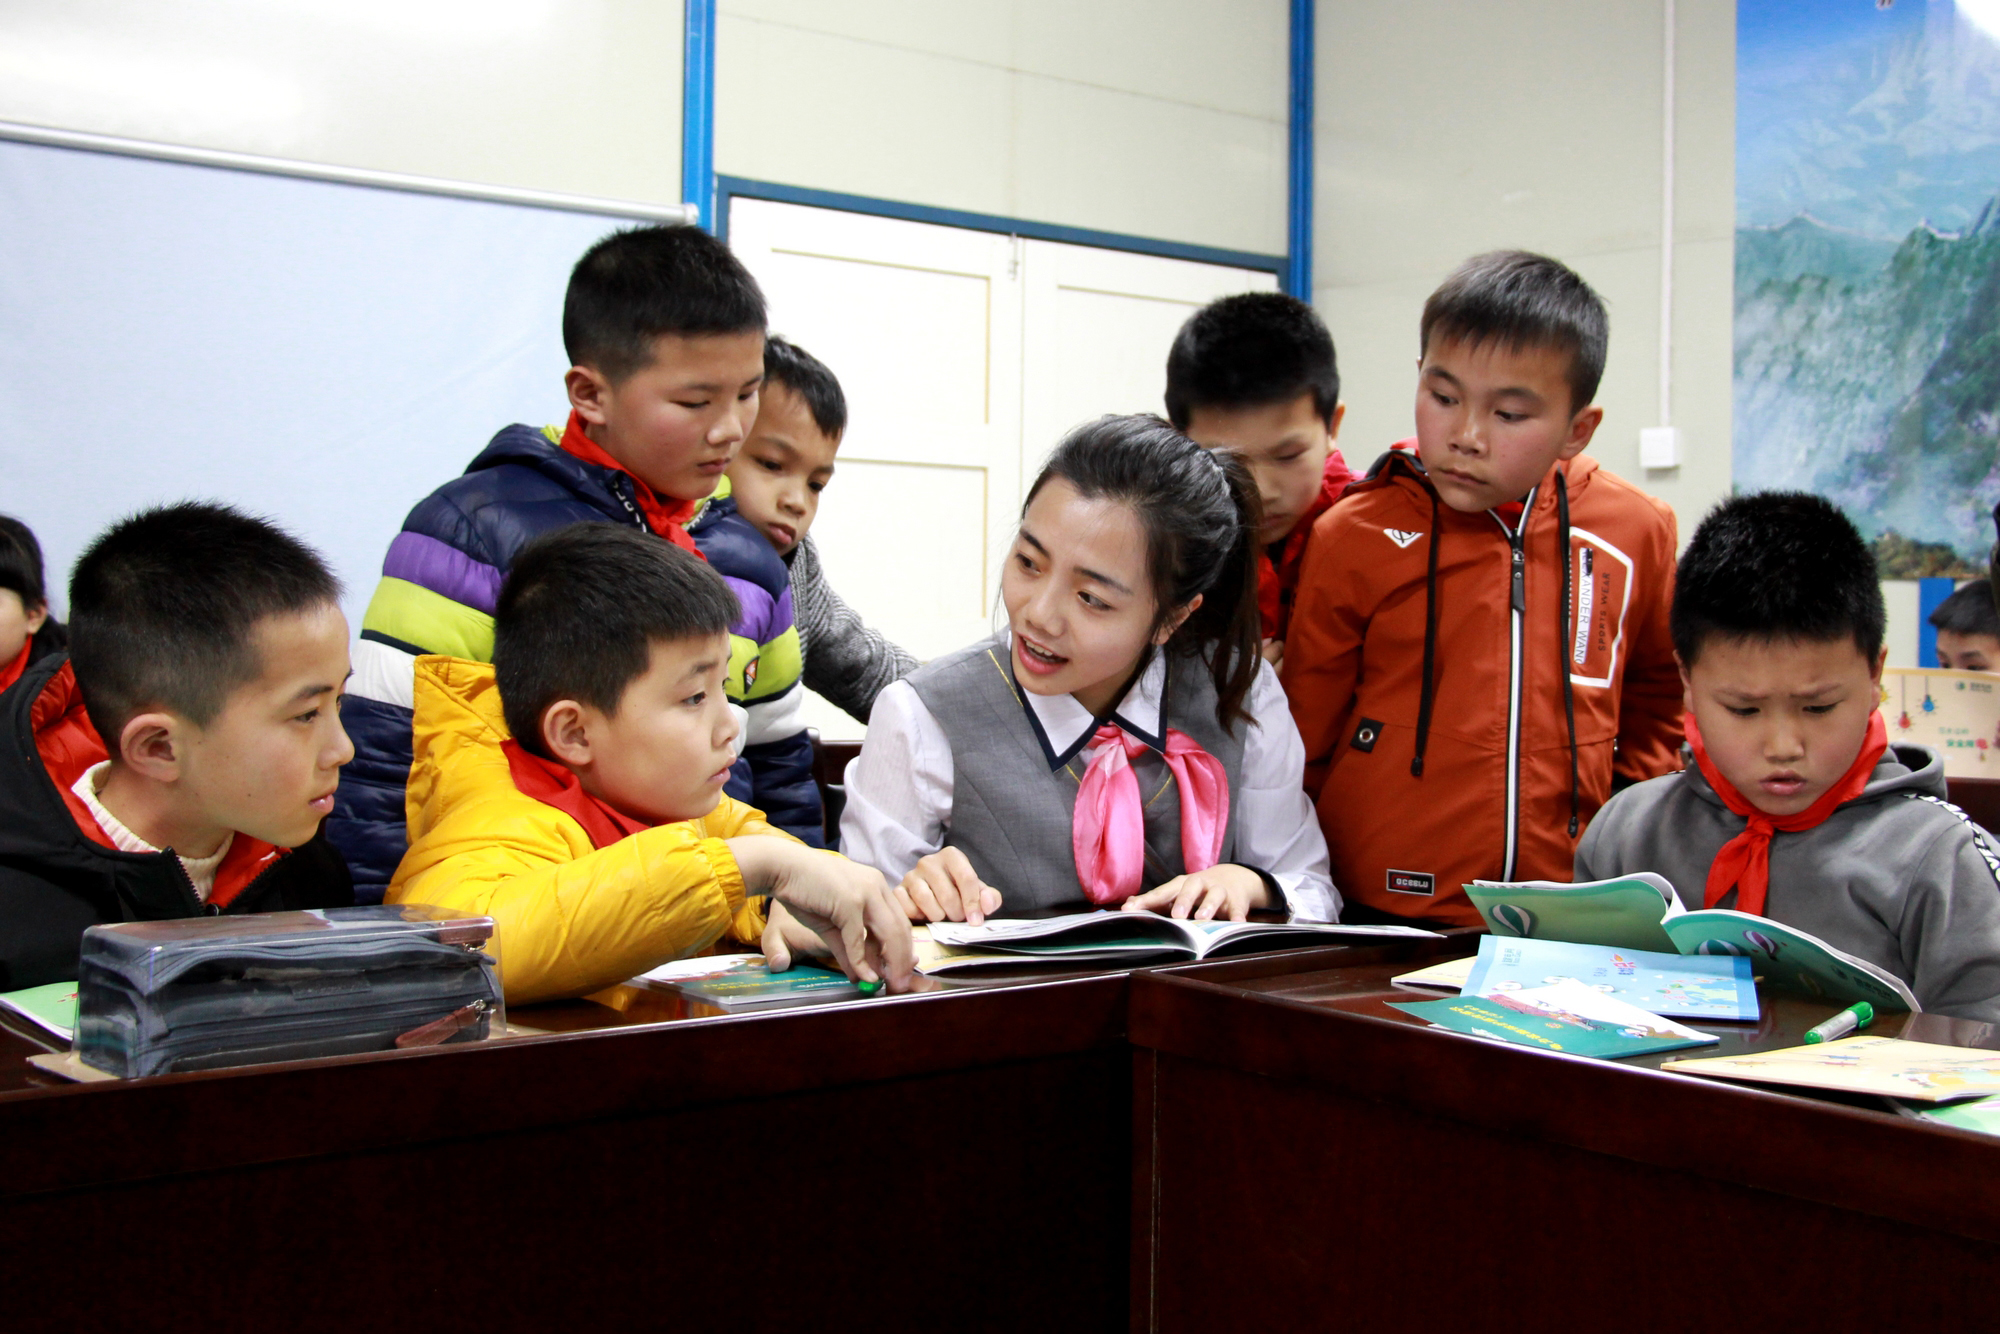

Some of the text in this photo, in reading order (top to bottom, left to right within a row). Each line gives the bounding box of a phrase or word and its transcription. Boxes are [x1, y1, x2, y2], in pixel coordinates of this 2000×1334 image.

[1579, 549, 1592, 624] XANDER
[1598, 572, 1611, 652] SPORTS WEAR
